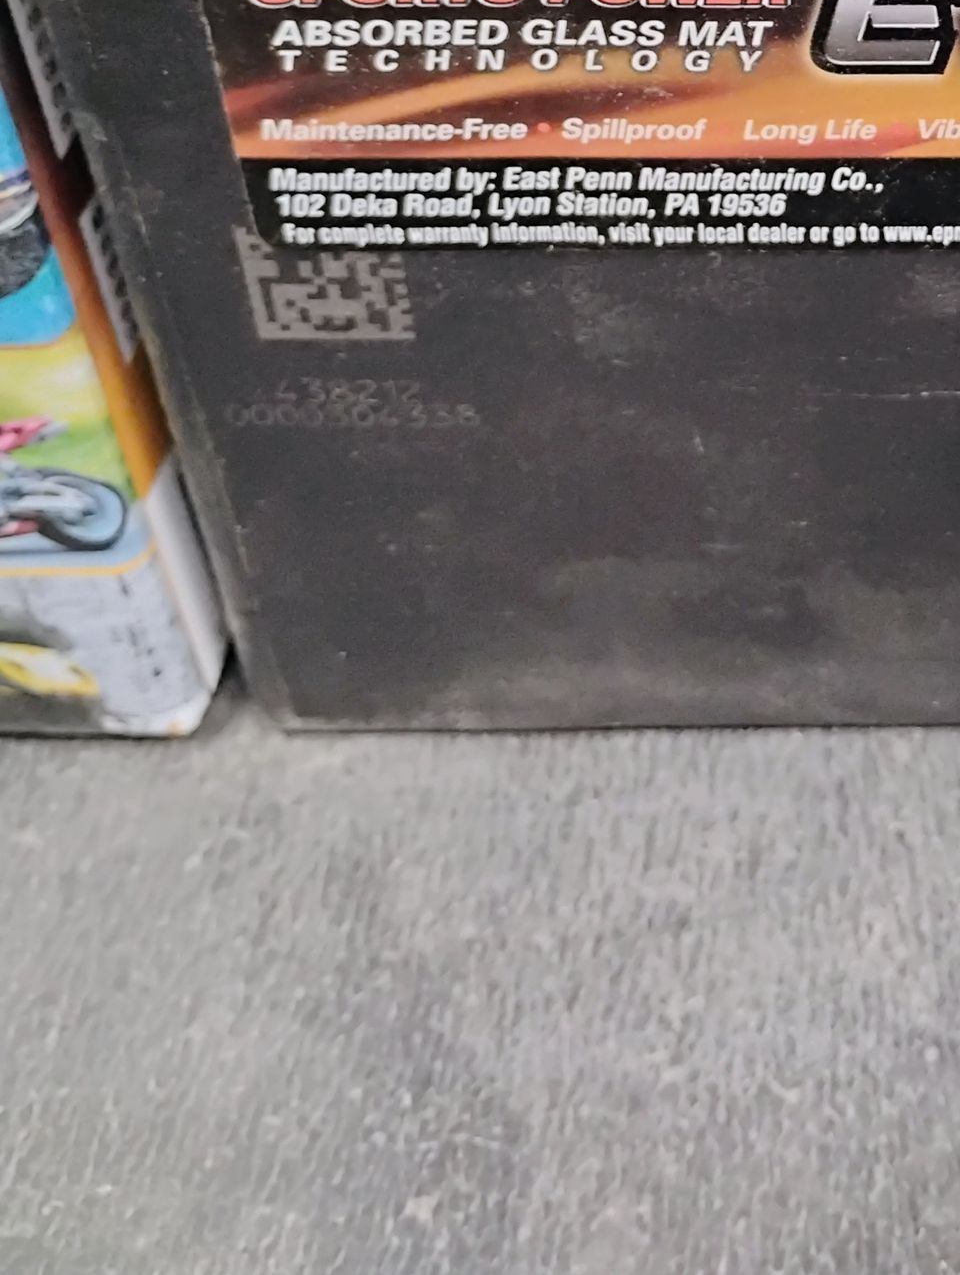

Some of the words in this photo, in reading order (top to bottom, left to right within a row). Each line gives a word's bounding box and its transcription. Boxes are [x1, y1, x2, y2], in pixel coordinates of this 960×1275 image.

[271, 19, 509, 48] ABSORBED
[520, 19, 666, 48] GLASS
[676, 19, 774, 48] MAT
[261, 119, 528, 142] Maintenance-Free
[561, 118, 706, 144] Spillproof
[742, 120, 816, 144] Long
[824, 119, 877, 141] Life
[268, 167, 451, 192] Manufactured
[456, 167, 497, 195] by:
[502, 166, 560, 191] East
[564, 166, 632, 191] Penn
[637, 167, 826, 196] Manufacturing
[831, 166, 884, 193] Co.,
[273, 194, 326, 218] 102
[330, 194, 398, 218] Deka
[402, 193, 481, 219] Road,
[488, 193, 551, 221] Lyon
[556, 192, 657, 219] Station,
[664, 193, 700, 217] PA
[707, 193, 788, 217] 19536
[280, 223, 315, 244] For
[316, 223, 405, 248] complete
[405, 223, 489, 248] warranty
[490, 222, 605, 246] information,
[608, 222, 651, 244] visit
[653, 226, 694, 247] your
[697, 222, 744, 244] local
[747, 222, 806, 244] dealer
[809, 226, 830, 244] or
[833, 227, 857, 247] go
[859, 223, 880, 244] to
